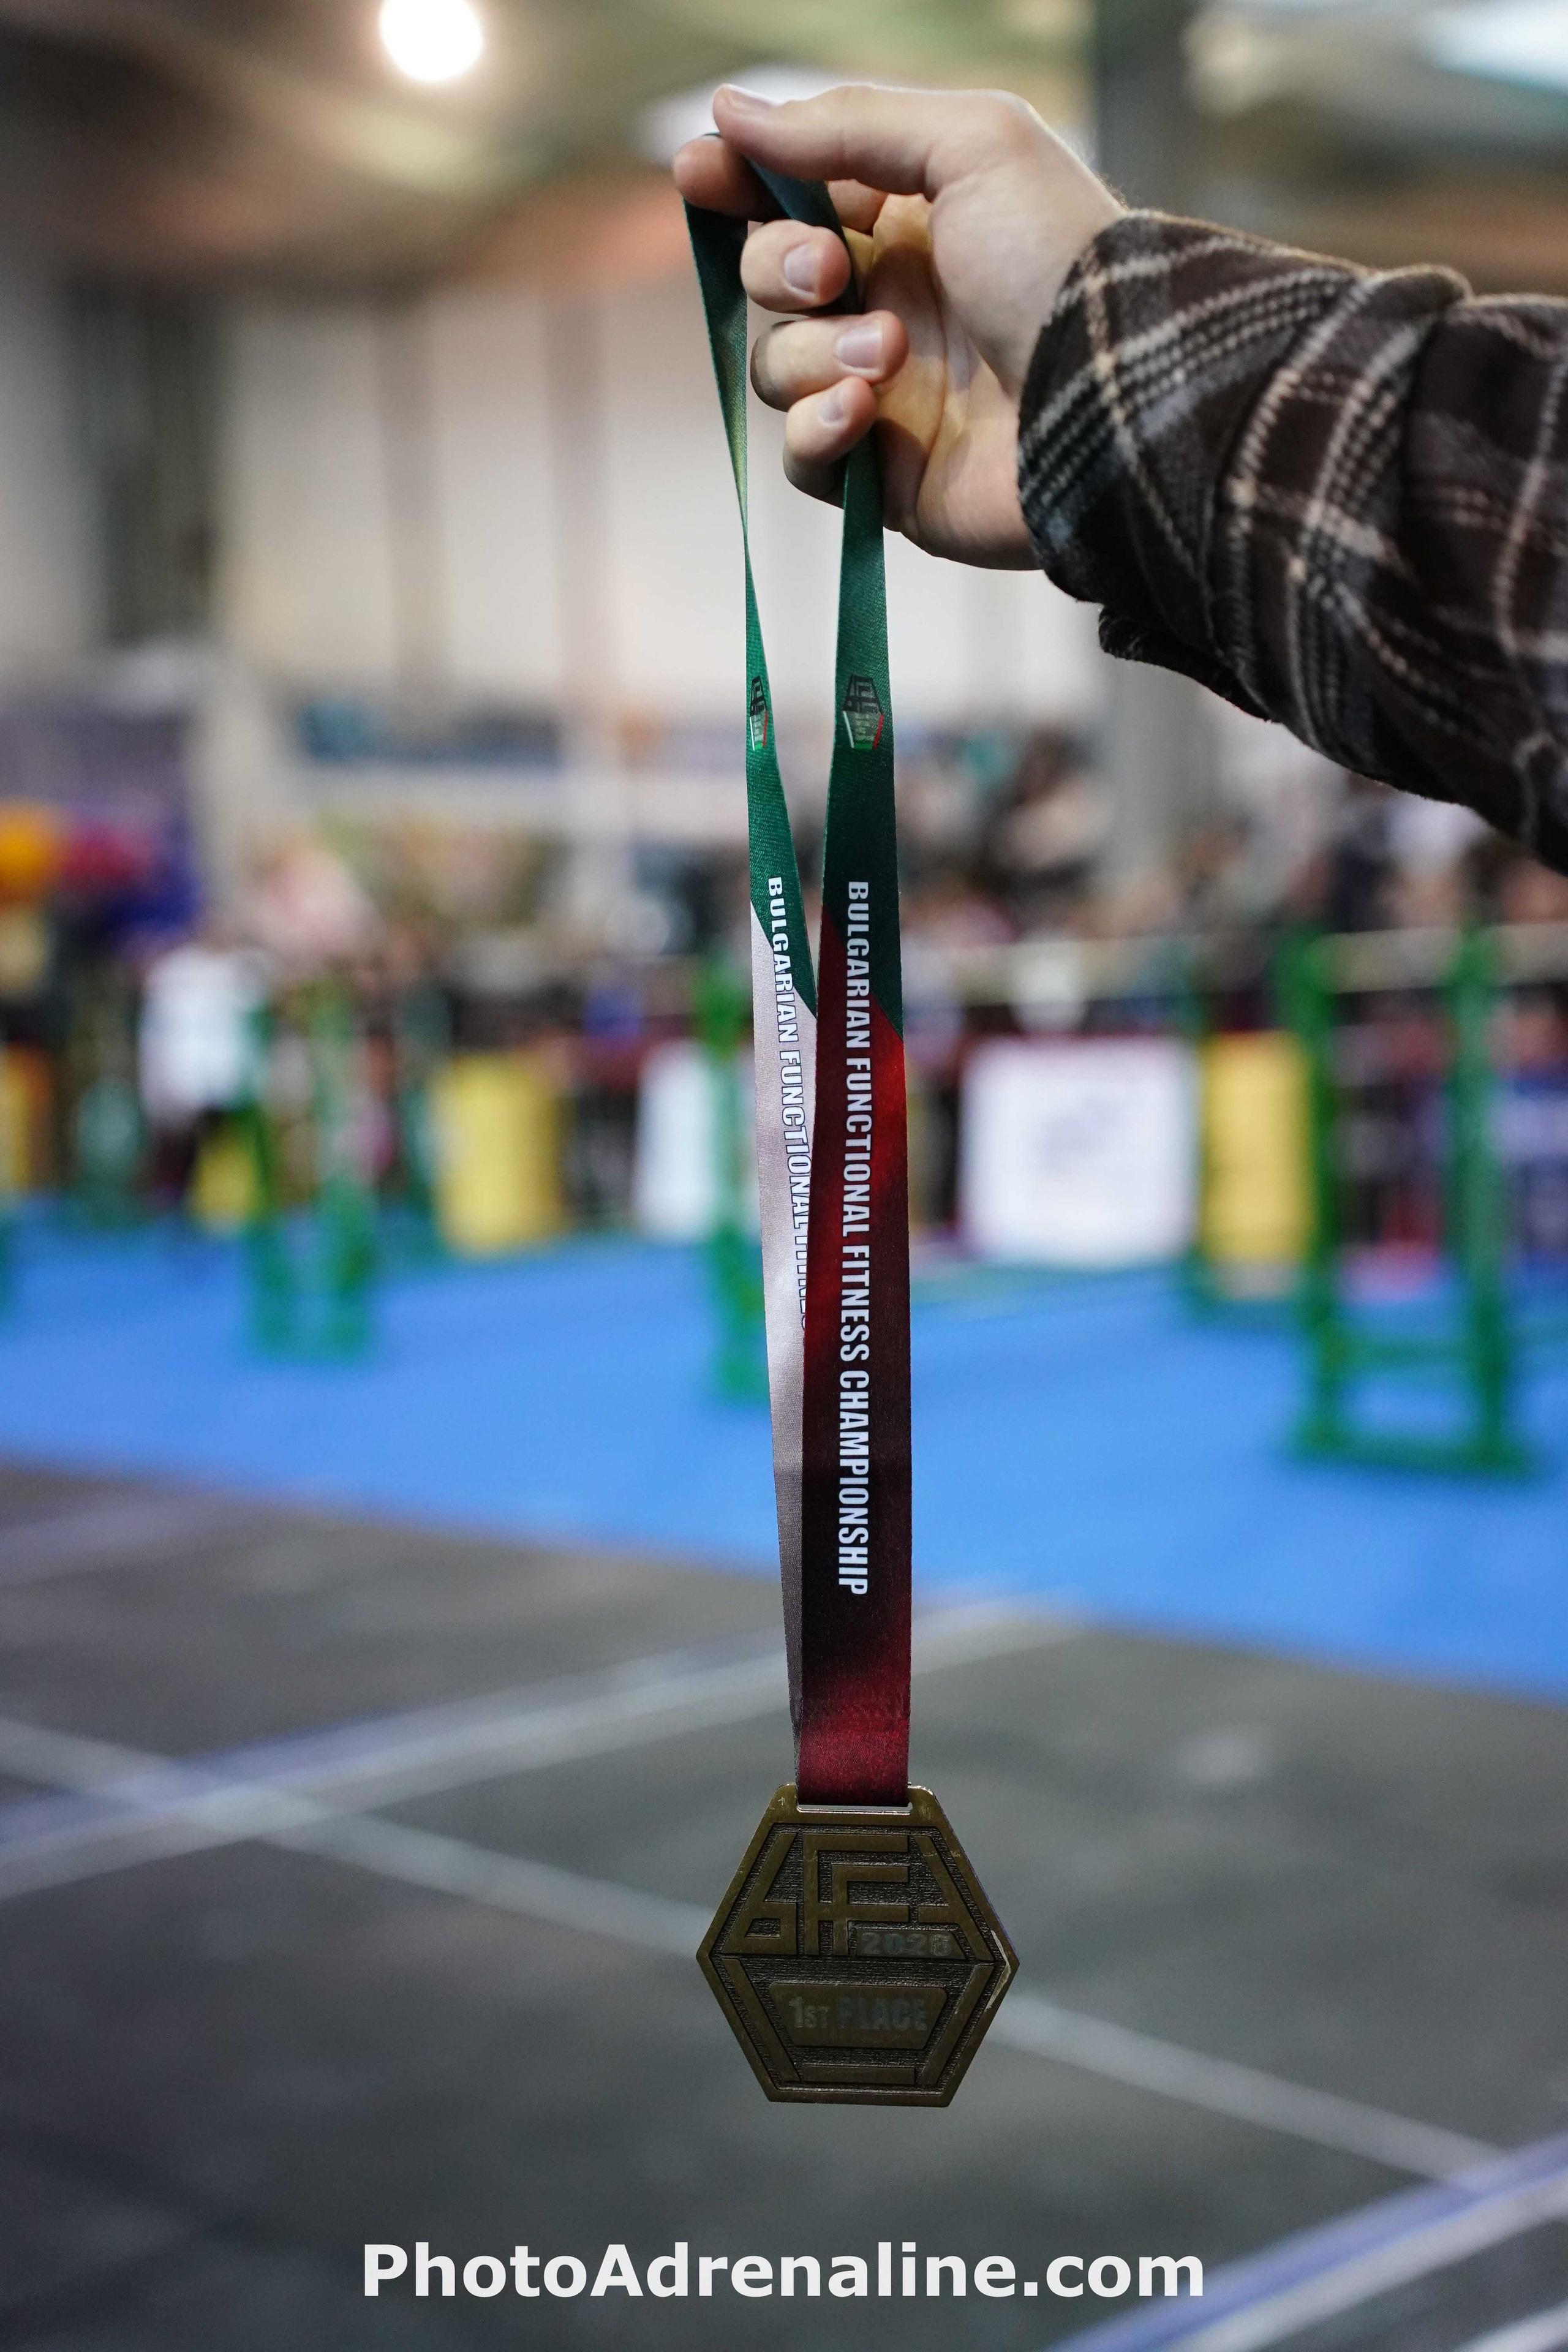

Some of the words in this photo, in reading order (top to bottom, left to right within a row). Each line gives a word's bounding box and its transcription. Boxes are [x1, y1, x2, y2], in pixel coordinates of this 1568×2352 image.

[768, 876, 799, 1042] BULGARIAN
[846, 881, 872, 1049] BULGARIAN
[842, 1058, 872, 1237] FUNCTIONAL
[840, 1245, 870, 1362] FITNESS
[839, 1370, 870, 1595] CHAMPIONSHIP
[837, 1997, 927, 2030] PLACE
